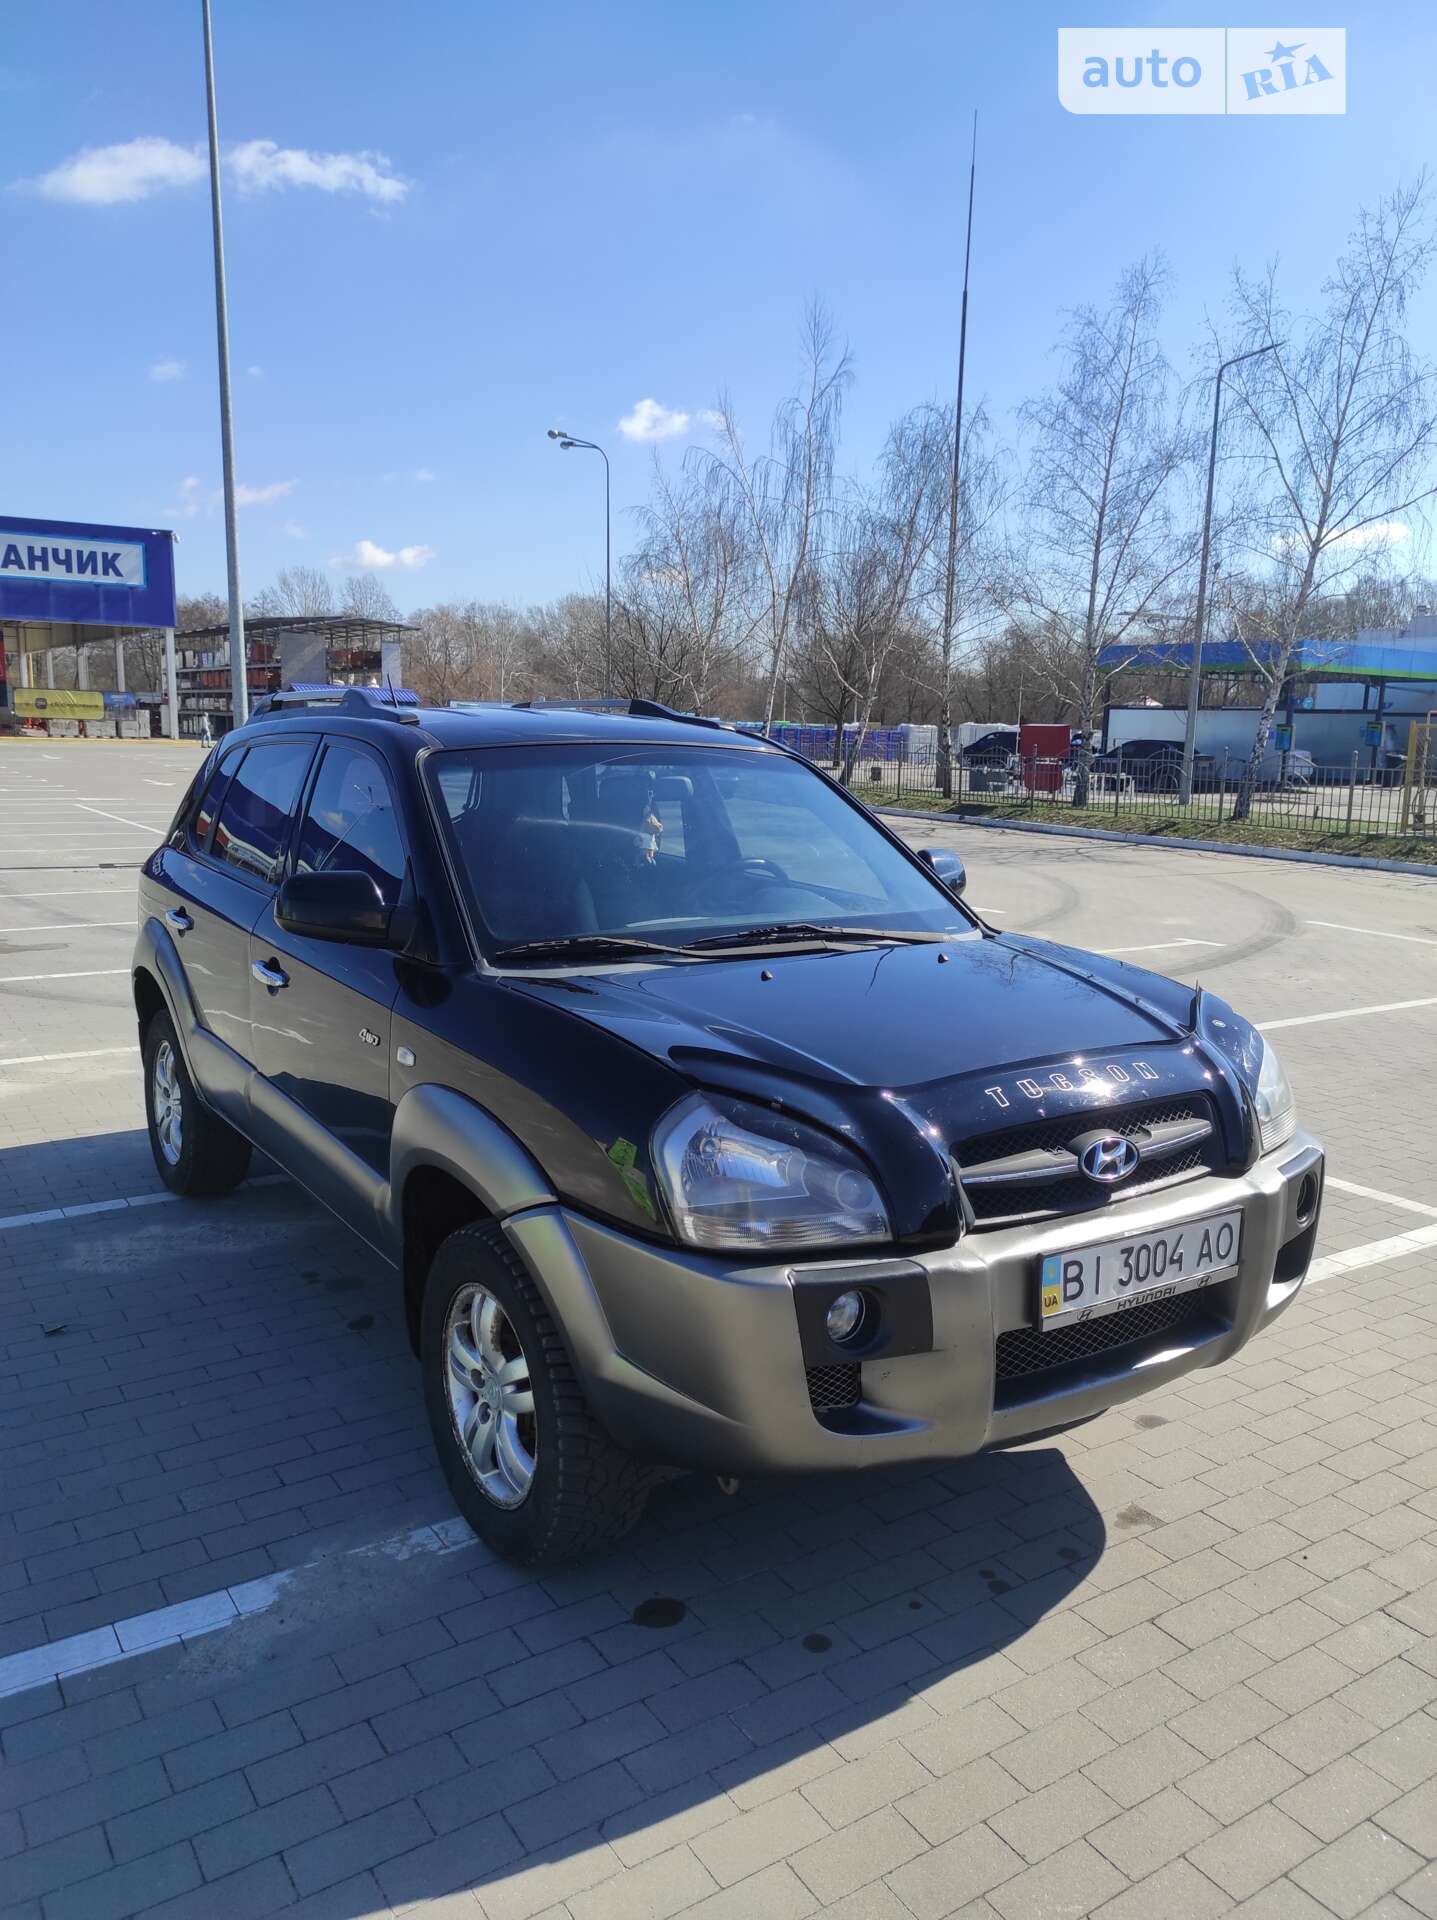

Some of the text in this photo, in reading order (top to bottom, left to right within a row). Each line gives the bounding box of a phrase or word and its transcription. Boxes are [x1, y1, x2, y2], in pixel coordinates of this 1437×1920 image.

[1, 544, 124, 577] АНЧИК
[984, 1062, 1159, 1108] TUCSON
[1062, 1222, 1234, 1304] BI 3004 AO
[1043, 1294, 1059, 1309] UA
[1117, 1286, 1176, 1311] HYUNDAI
